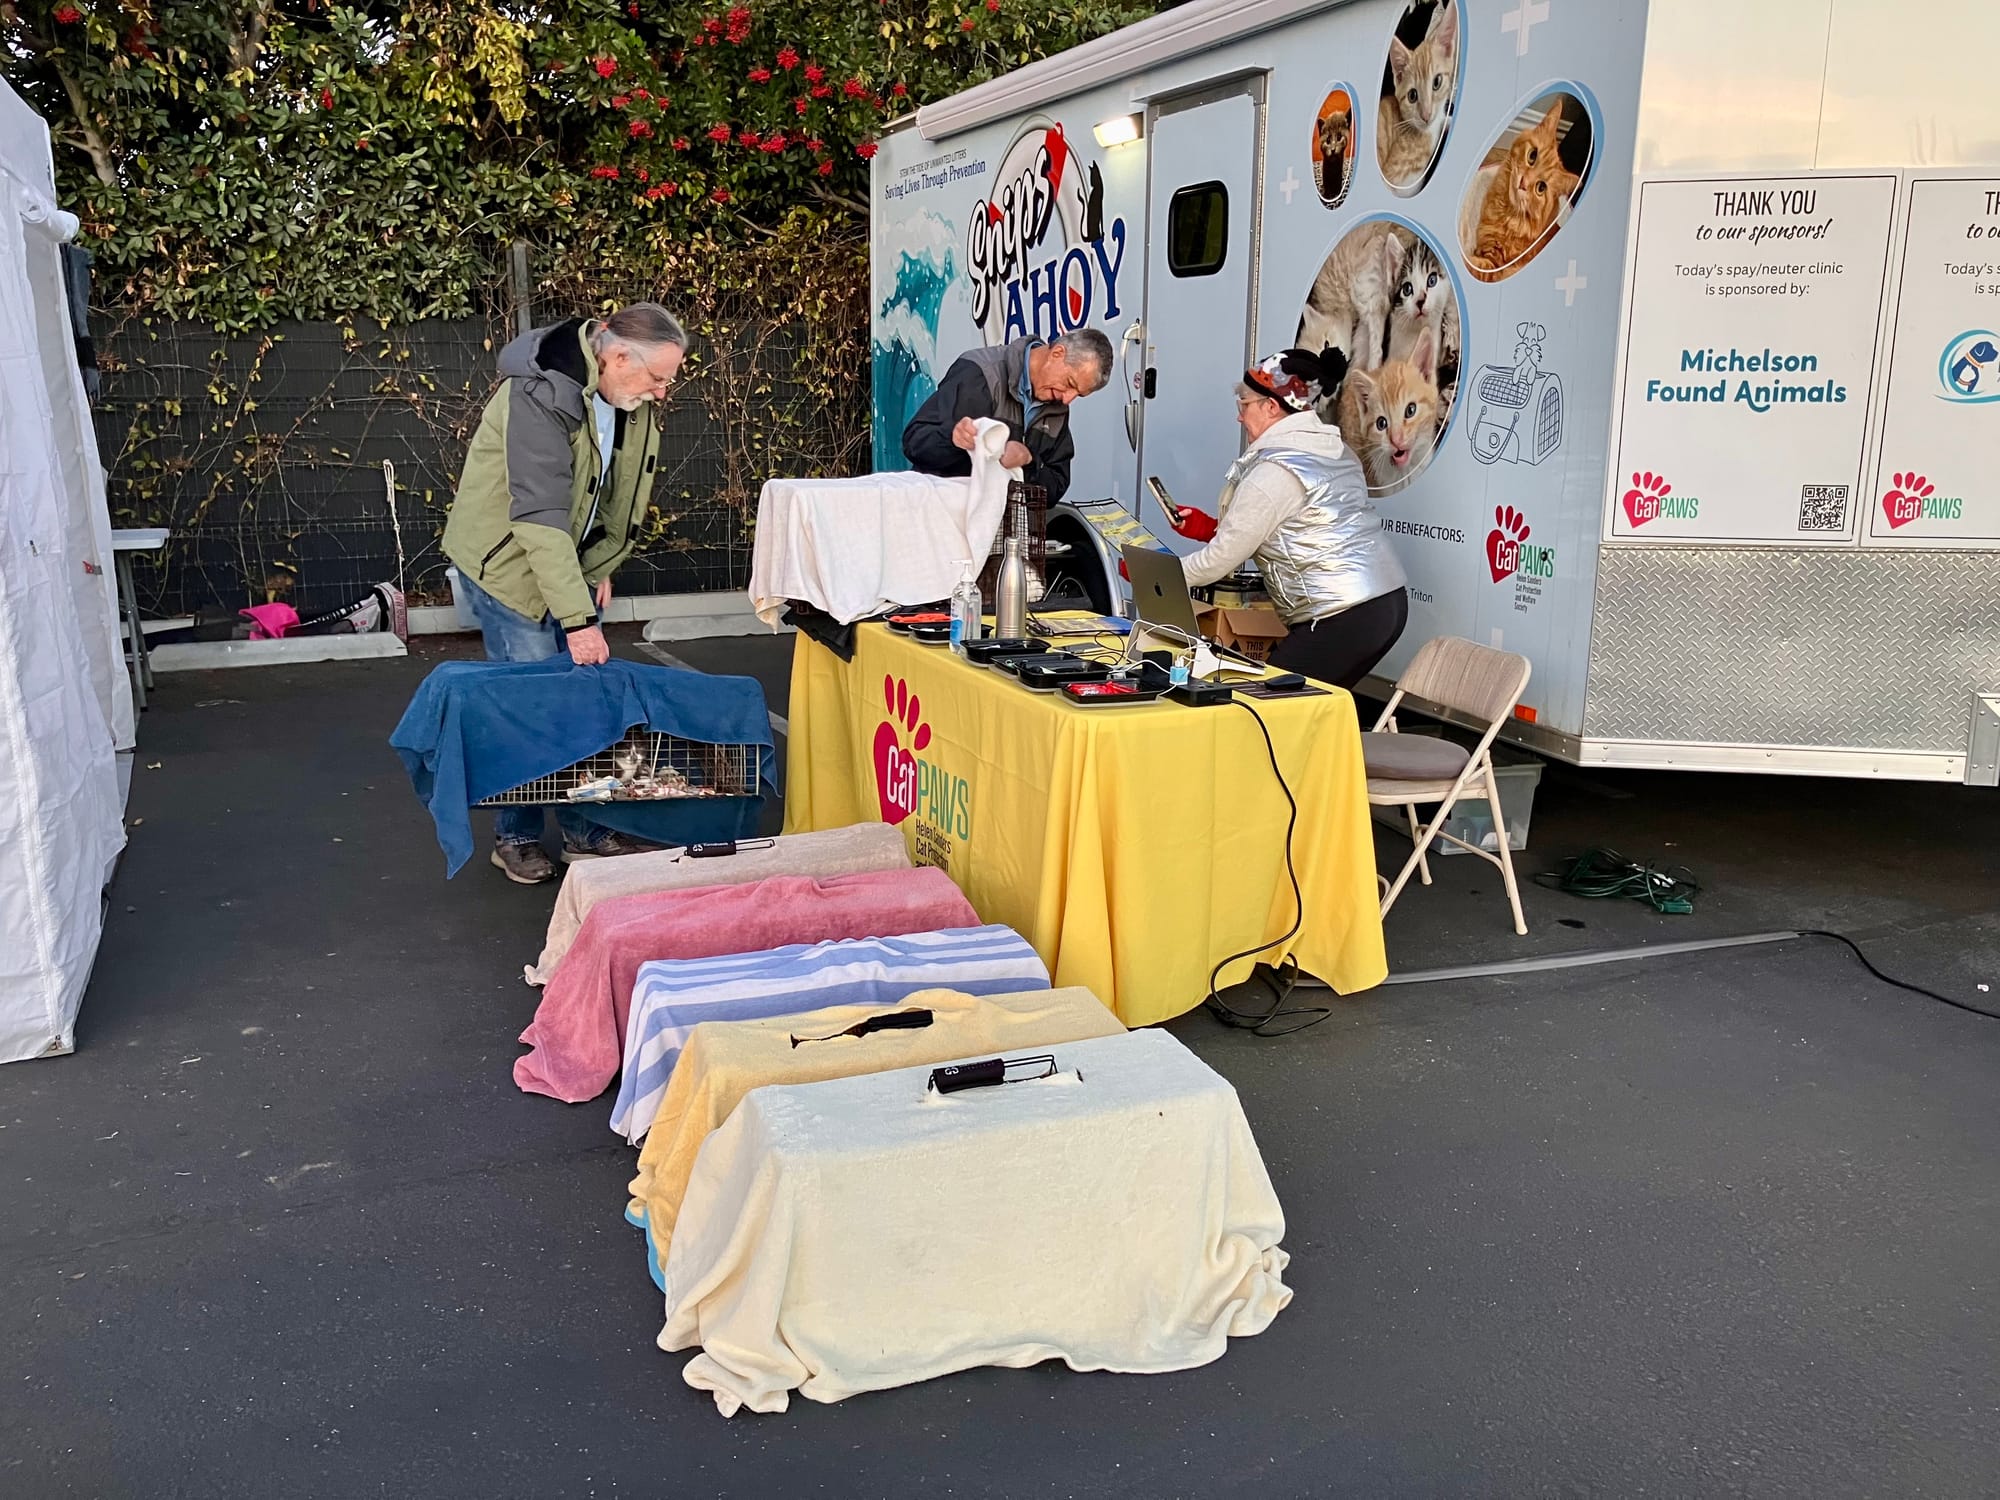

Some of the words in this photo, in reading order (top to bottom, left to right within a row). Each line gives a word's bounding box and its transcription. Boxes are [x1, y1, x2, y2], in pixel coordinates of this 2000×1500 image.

[885, 184, 904, 200] Saving
[904, 179, 920, 194] Lives
[921, 168, 948, 188] Through
[949, 159, 986, 182] Prevention
[1713, 190, 1775, 217] THANK
[1780, 189, 1817, 216] YOU
[967, 145, 1055, 329] Snips
[1696, 224, 1713, 241] to
[1716, 225, 1747, 240] our
[1748, 217, 1833, 247] sponsors!
[1966, 223, 1983, 239] to
[1004, 217, 1126, 346] AHOY
[1675, 263, 1723, 278] Today's
[1726, 263, 1806, 278] spay/neuter
[1808, 262, 1843, 275] clinic
[1944, 263, 1994, 277] Today's
[1705, 284, 1715, 295] is
[1718, 283, 1787, 297] sponsored
[1790, 282, 1810, 297] by:
[1974, 282, 1985, 295] is
[1680, 348, 1818, 373] Michelson
[1646, 379, 1727, 403] Found
[1733, 379, 1847, 413] Animals
[1395, 520, 1465, 543] BENEFACTORS:
[1410, 588, 1433, 603] Triton
[1246, 641, 1264, 652] THIS
[915, 818, 933, 841] Helen
[915, 837, 927, 857] Cat
